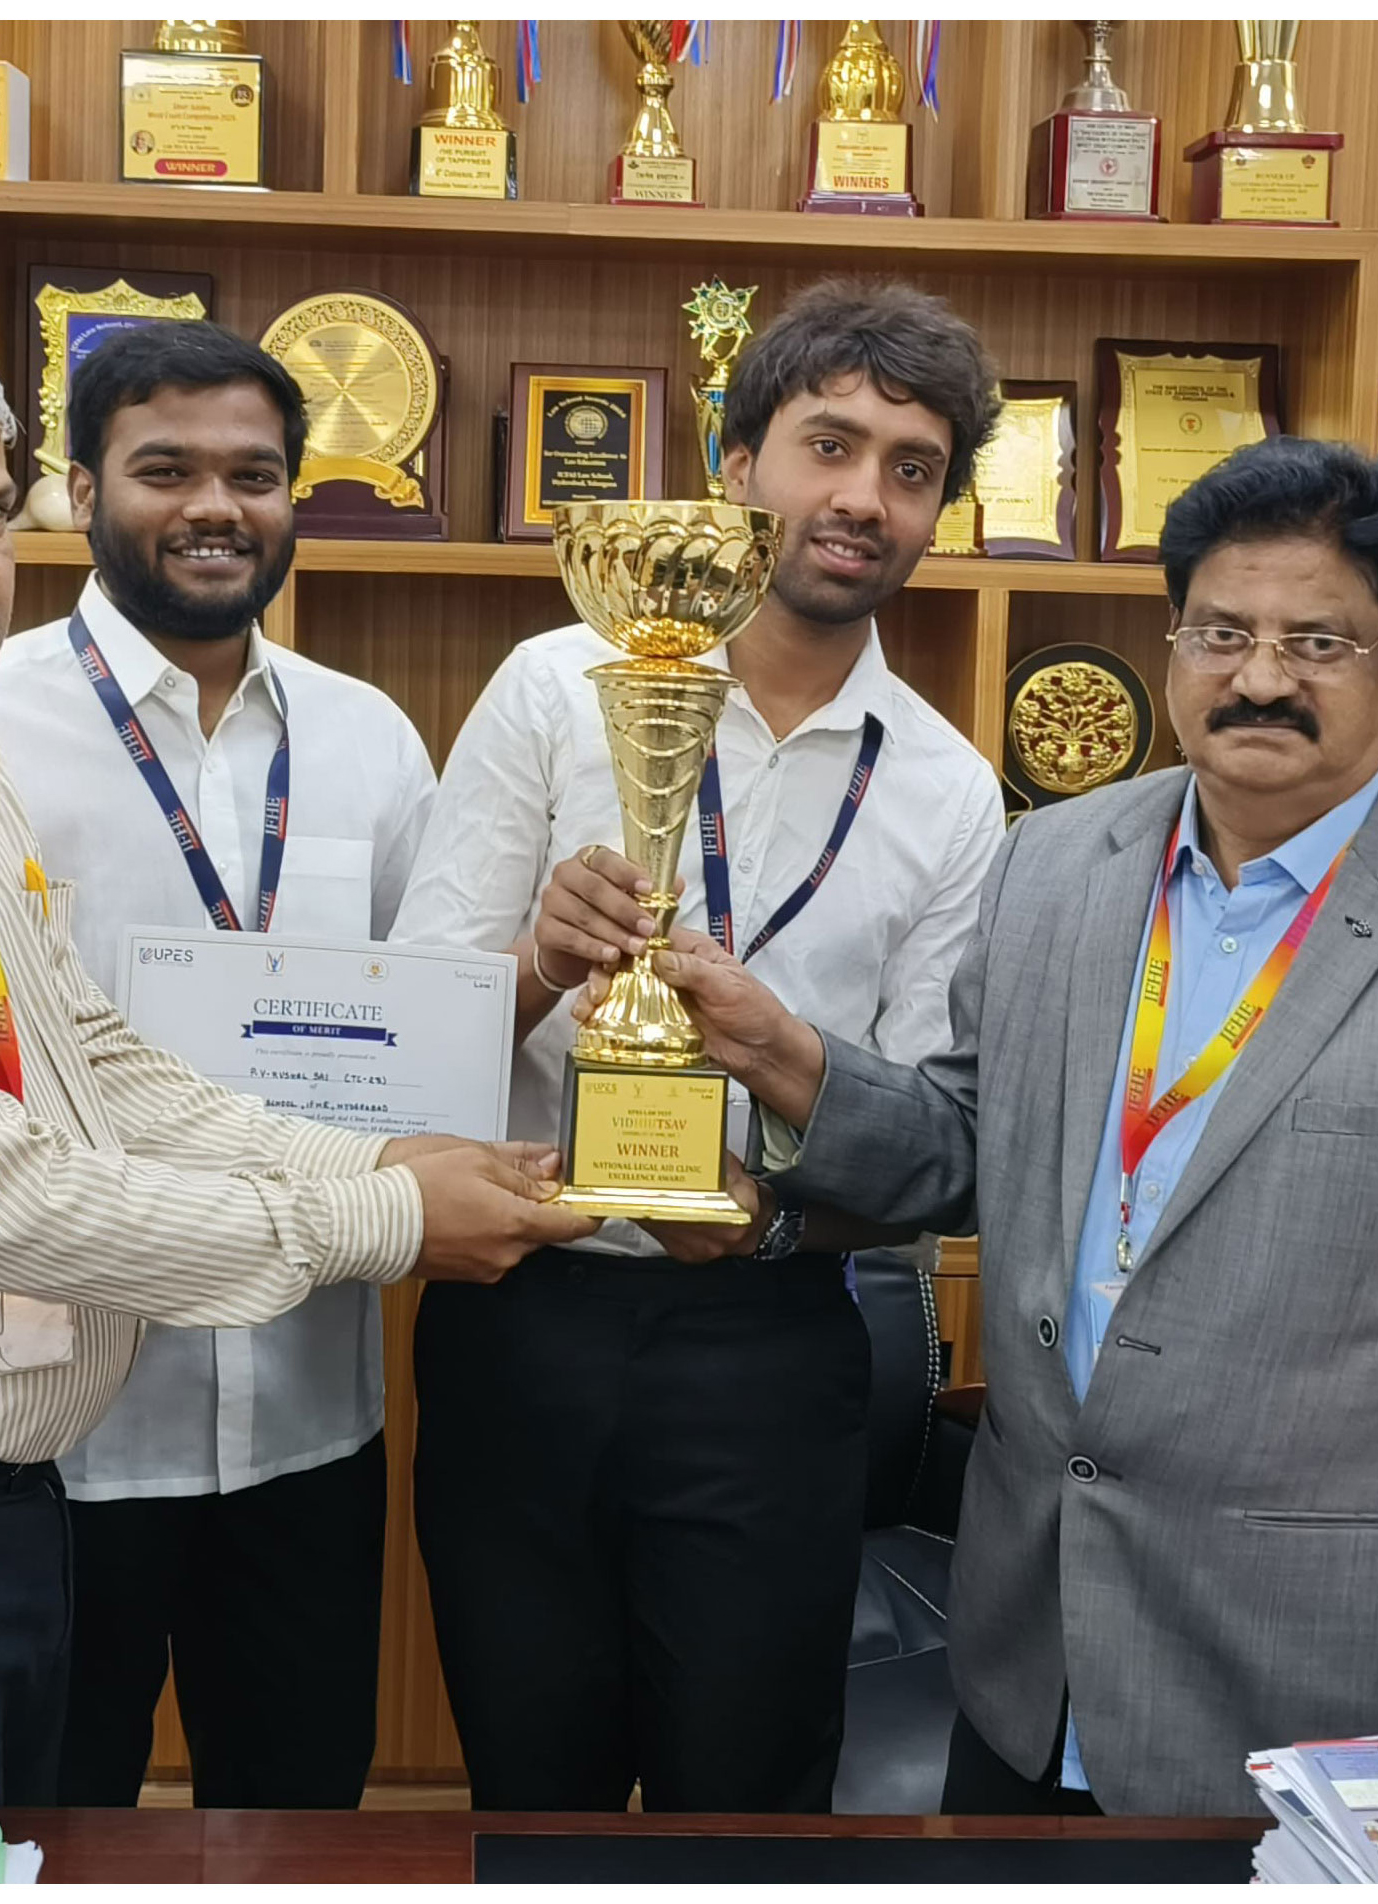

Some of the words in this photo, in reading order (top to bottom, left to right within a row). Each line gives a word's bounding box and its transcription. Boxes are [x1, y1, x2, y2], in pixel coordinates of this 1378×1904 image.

[434, 134, 497, 147] WINNER
[165, 162, 216, 172] WINNER
[833, 176, 889, 189] WINNERS
[78, 649, 103, 682] IFHE
[116, 722, 148, 763] IFHE
[848, 763, 868, 801] IFHE
[265, 797, 281, 836] IFHE
[168, 809, 195, 852] IFHE
[701, 813, 718, 856] IFHE
[208, 901, 229, 930] HE
[154, 949, 194, 963] UPES
[454, 970, 482, 980] School
[474, 980, 491, 988] Law
[1144, 958, 1164, 1004] IFHE
[253, 998, 383, 1021] CERTIFICATE
[292, 1024, 307, 1034] OF
[309, 1025, 342, 1036] MERIT
[1220, 1000, 1257, 1043] IFHE
[270, 1049, 303, 1057] certificate
[311, 1051, 336, 1060] proudly
[1129, 1066, 1147, 1113] IFHE
[1147, 1089, 1184, 1128] IFHE
[616, 1143, 680, 1158] WINNER
[593, 1161, 631, 1171] NATIONAL
[633, 1163, 658, 1172] LEGAL
[660, 1164, 674, 1173] AID
[676, 1165, 702, 1174] CLINIC
[608, 1173, 655, 1182] EXCELLENCE
[657, 1174, 686, 1182] AWARD
